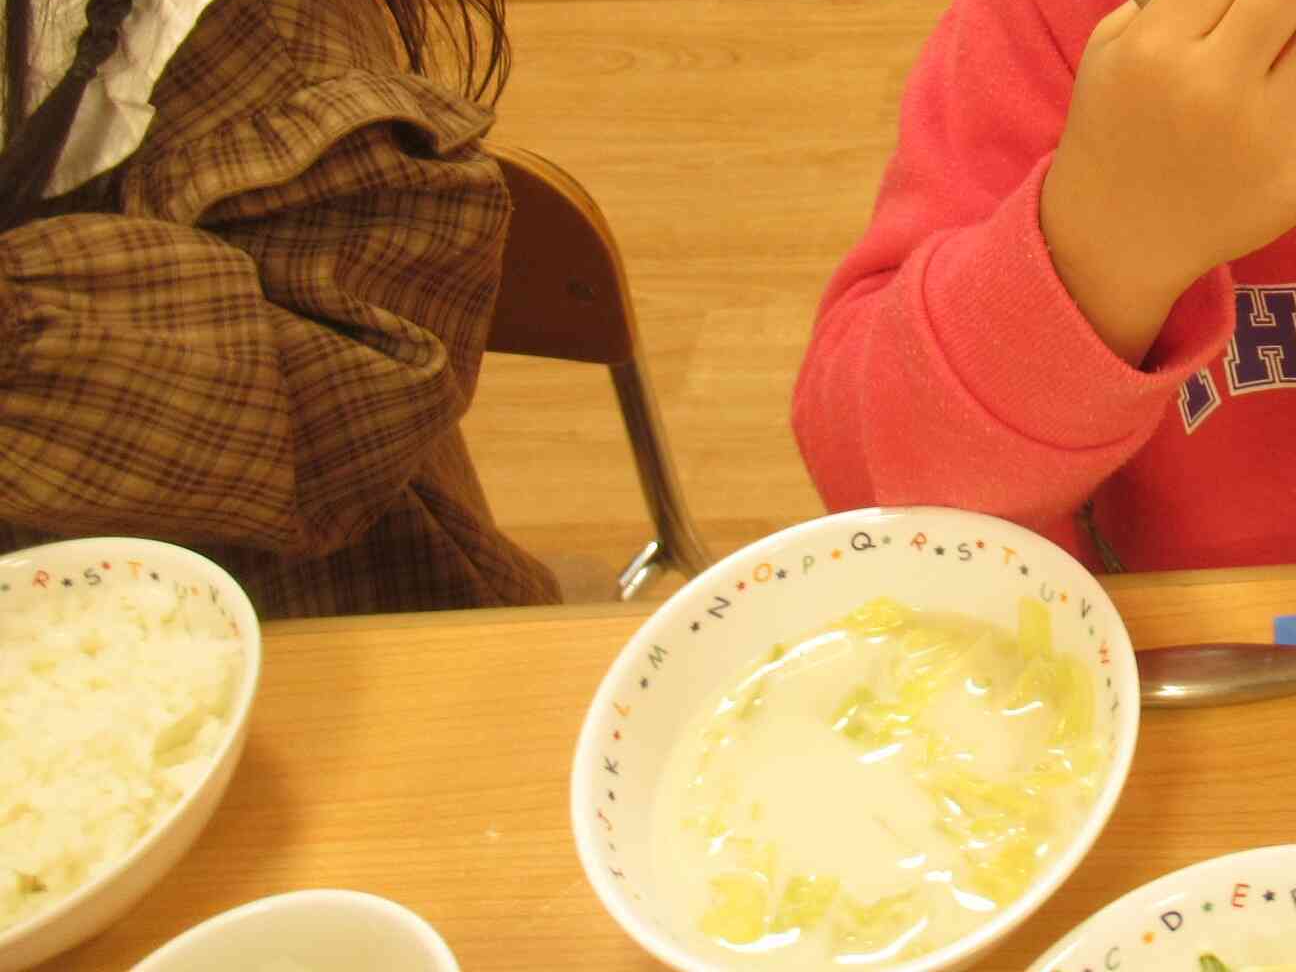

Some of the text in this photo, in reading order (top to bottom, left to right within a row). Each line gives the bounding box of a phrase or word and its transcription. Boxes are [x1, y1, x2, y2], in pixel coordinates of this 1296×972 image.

[707, 596, 731, 619] N
[851, 532, 876, 553] Q
[1160, 910, 1184, 931] D
[1230, 883, 1249, 908] E
